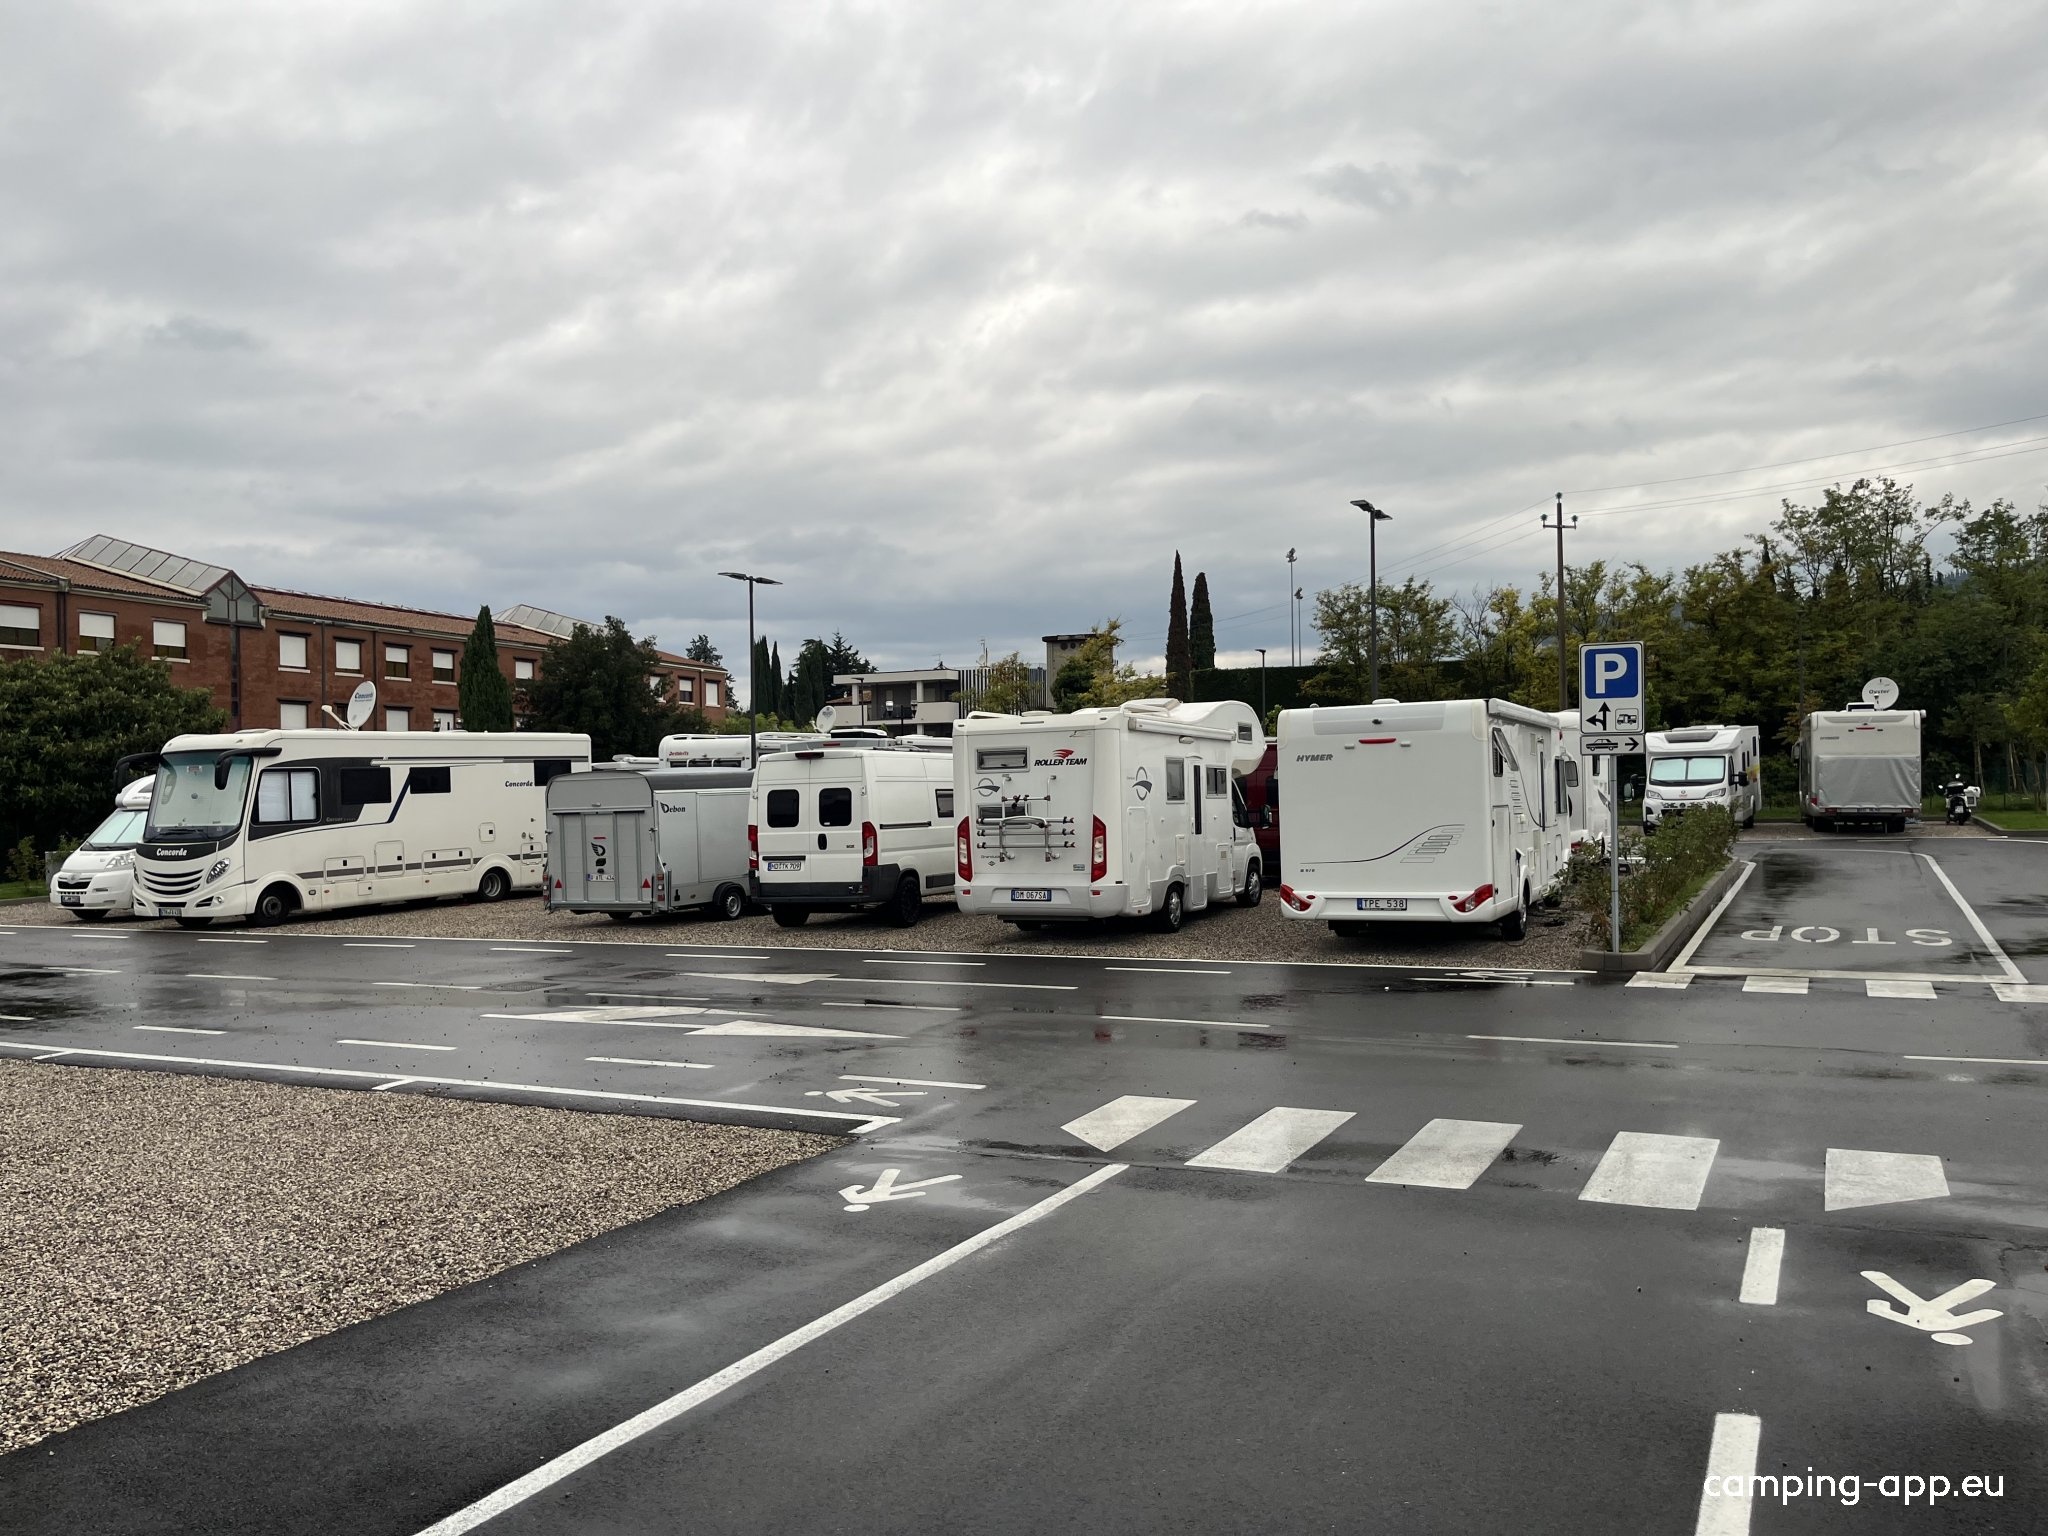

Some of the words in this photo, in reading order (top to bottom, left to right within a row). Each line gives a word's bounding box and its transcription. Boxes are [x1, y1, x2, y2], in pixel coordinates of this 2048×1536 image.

[1595, 653, 1627, 694] P
[1034, 759, 1064, 767] ROLLER
[1065, 758, 1087, 766] TEAM
[1296, 754, 1334, 762] HYMER
[504, 780, 534, 788] Concorde
[660, 802, 686, 814] Debon
[156, 847, 188, 857] Concorde
[1364, 899, 1381, 908] TPE
[1386, 899, 1405, 908] 538
[1740, 925, 1953, 947] STOP
